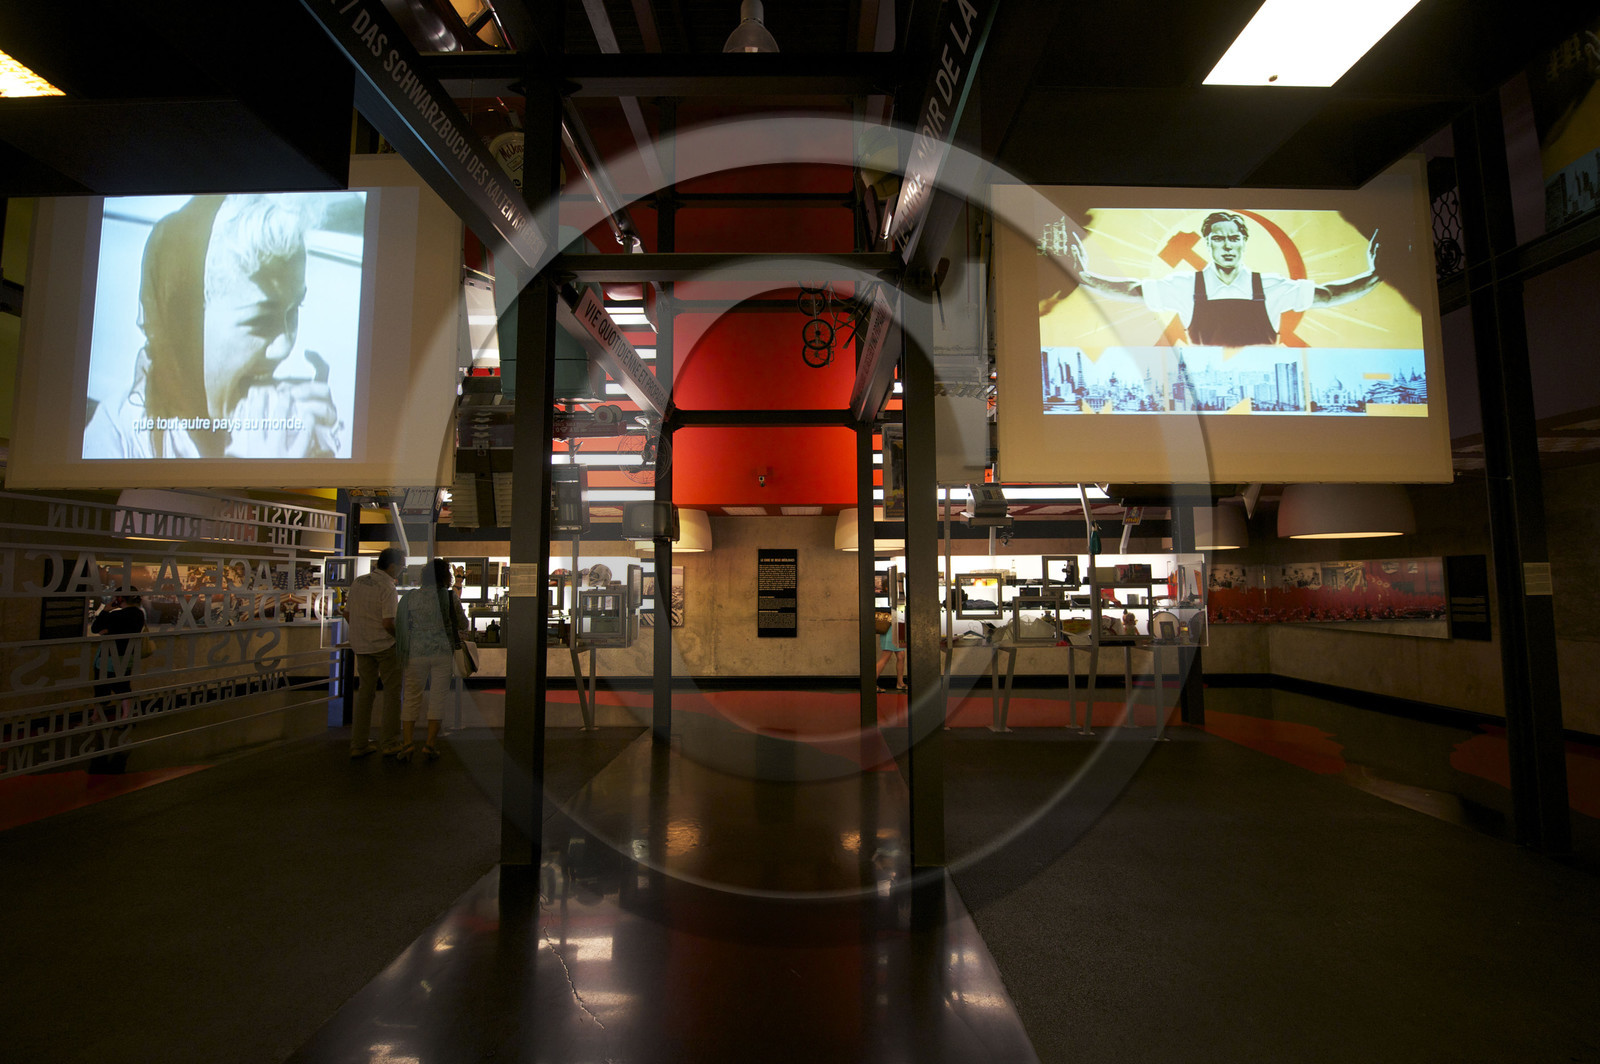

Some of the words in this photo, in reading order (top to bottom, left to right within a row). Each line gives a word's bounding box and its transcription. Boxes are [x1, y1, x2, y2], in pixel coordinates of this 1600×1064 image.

[352, 8, 389, 57] DAS
[383, 49, 472, 165] SCHWARZBUCH
[466, 154, 489, 184] DES
[485, 178, 518, 222] KALTEN
[917, 95, 946, 161] NOIR
[935, 43, 961, 106] DE
[949, 0, 978, 55] LA
[584, 299, 602, 328] VIE
[598, 318, 643, 379] QUOTIDIENNE
[132, 417, 155, 433] que
[156, 416, 180, 430] tout
[181, 417, 210, 430] autre
[212, 418, 241, 433] pays
[245, 418, 259, 430] au
